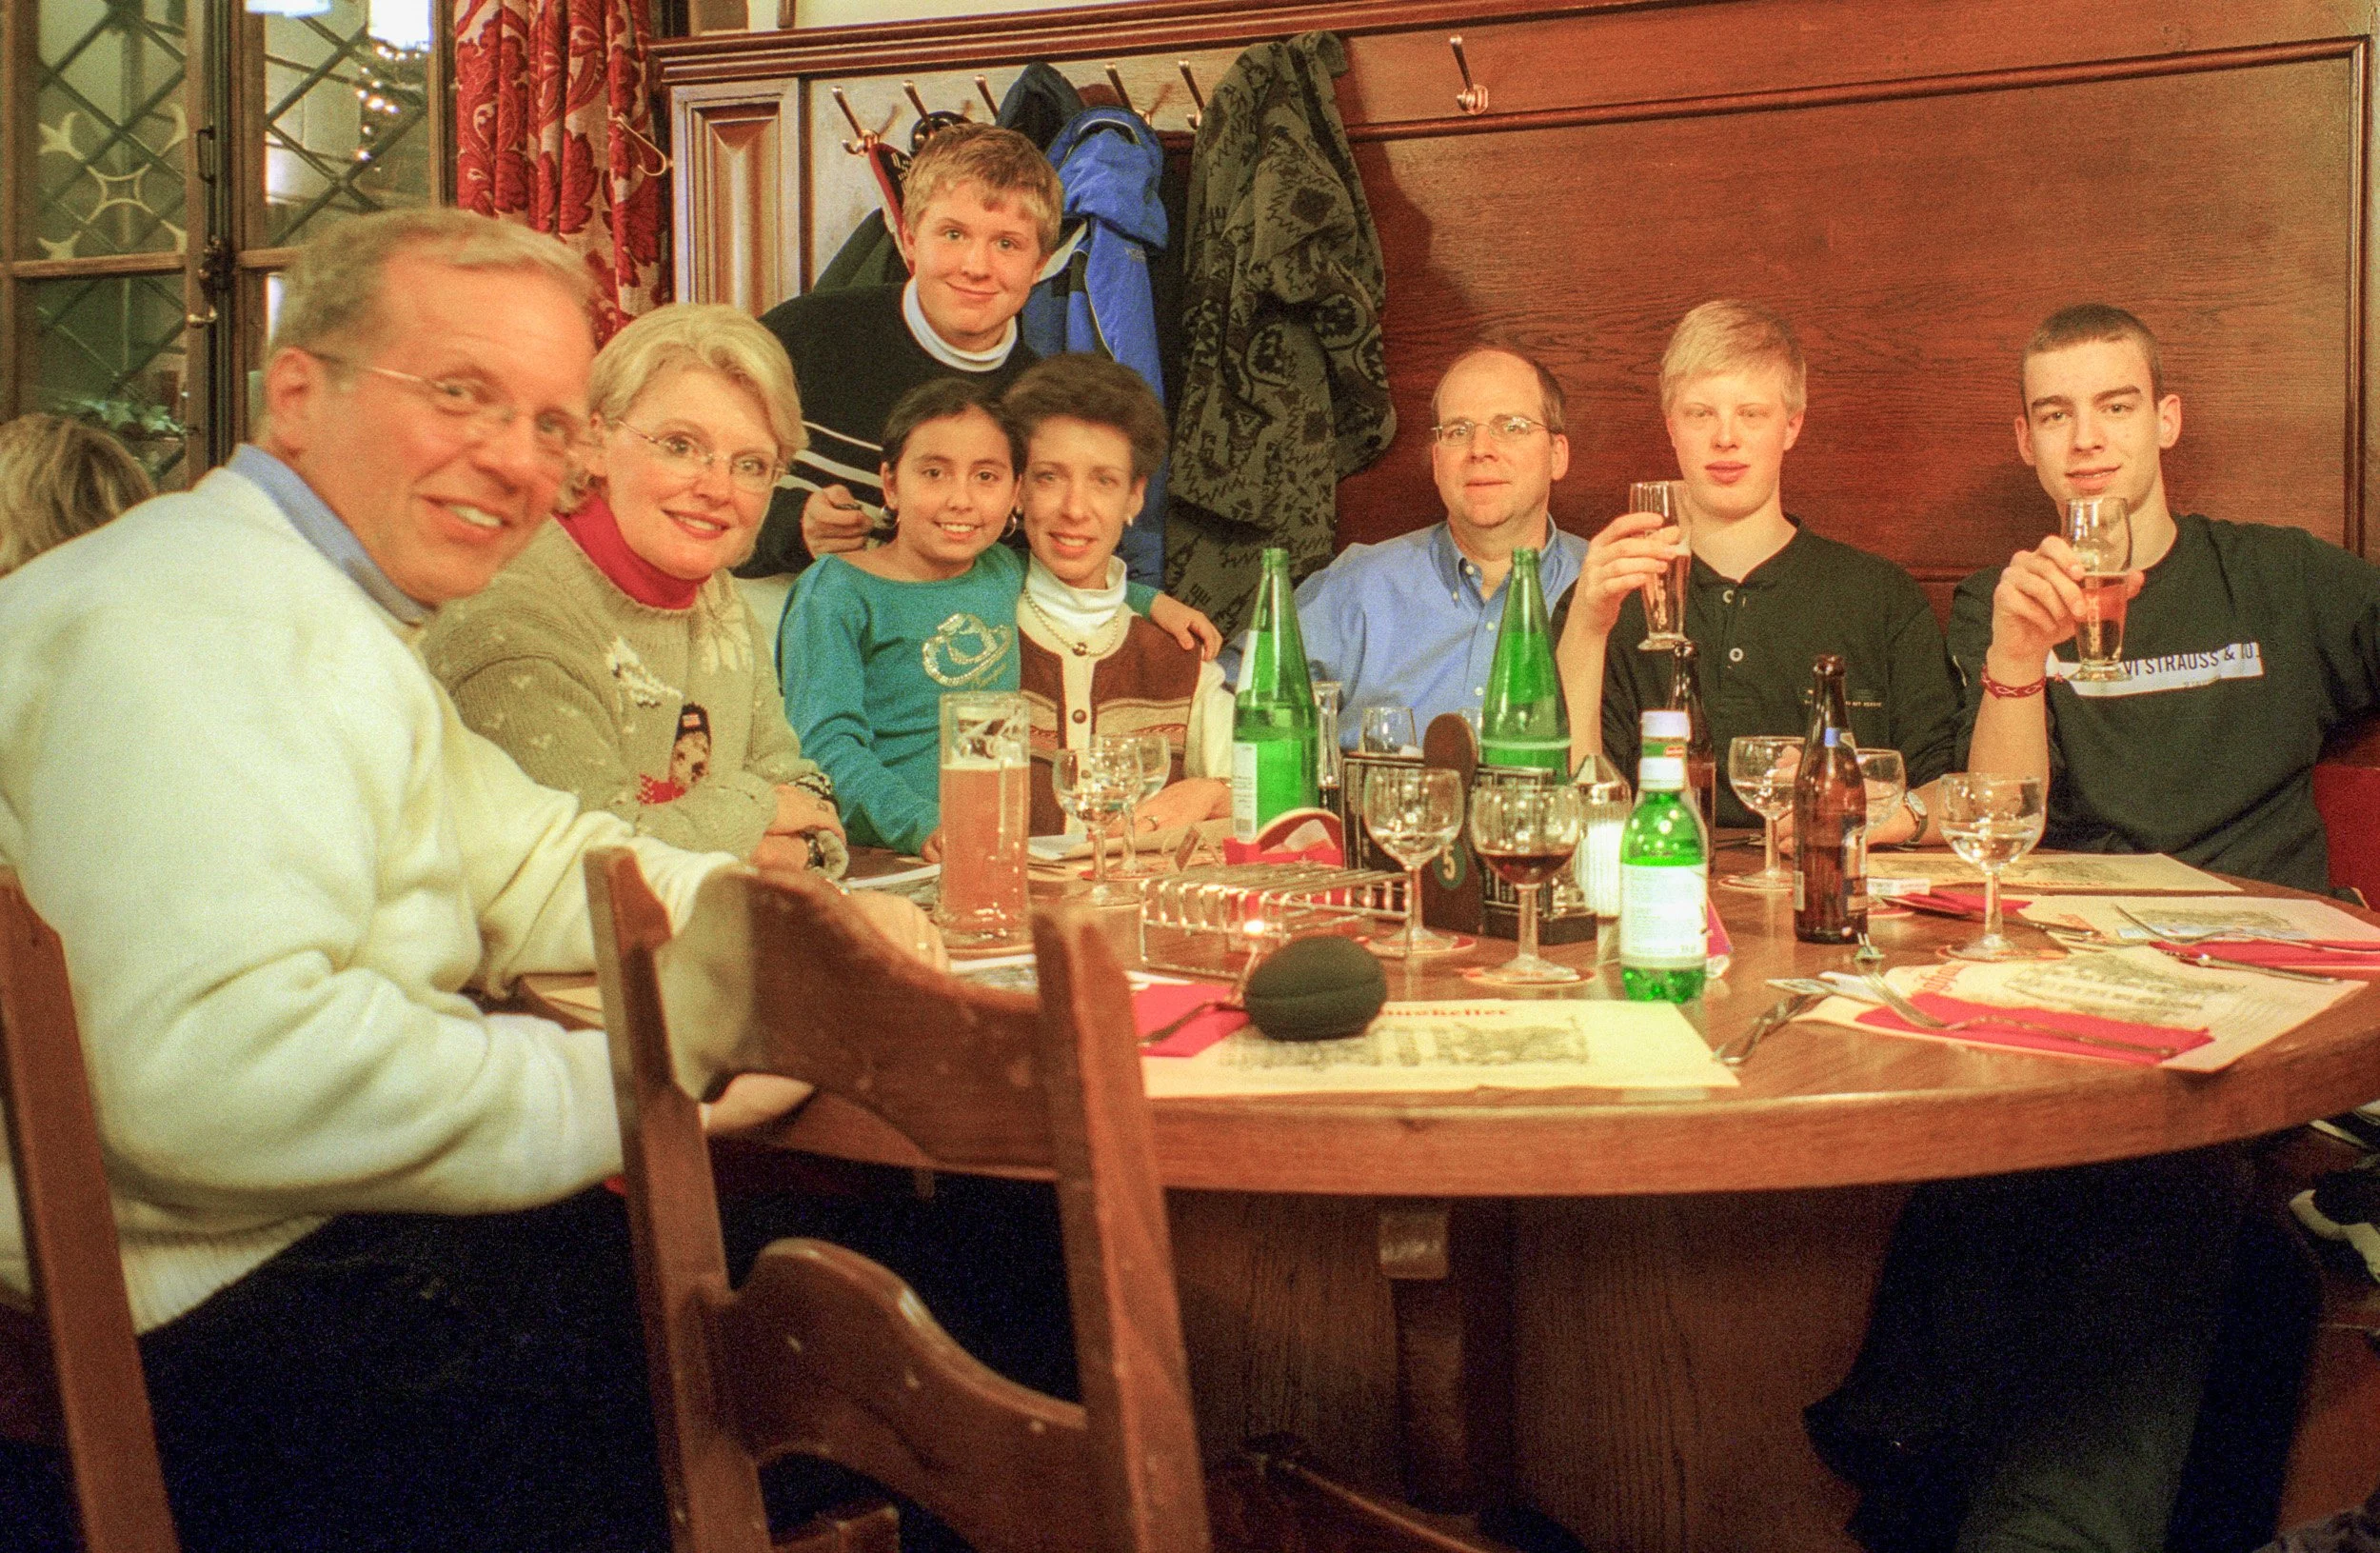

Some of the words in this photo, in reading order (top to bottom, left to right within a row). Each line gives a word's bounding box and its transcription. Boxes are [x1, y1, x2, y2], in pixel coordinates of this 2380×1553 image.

[2145, 652, 2219, 674] STRAUSS
[2224, 643, 2235, 661] &
[1442, 845, 1456, 880] 5
